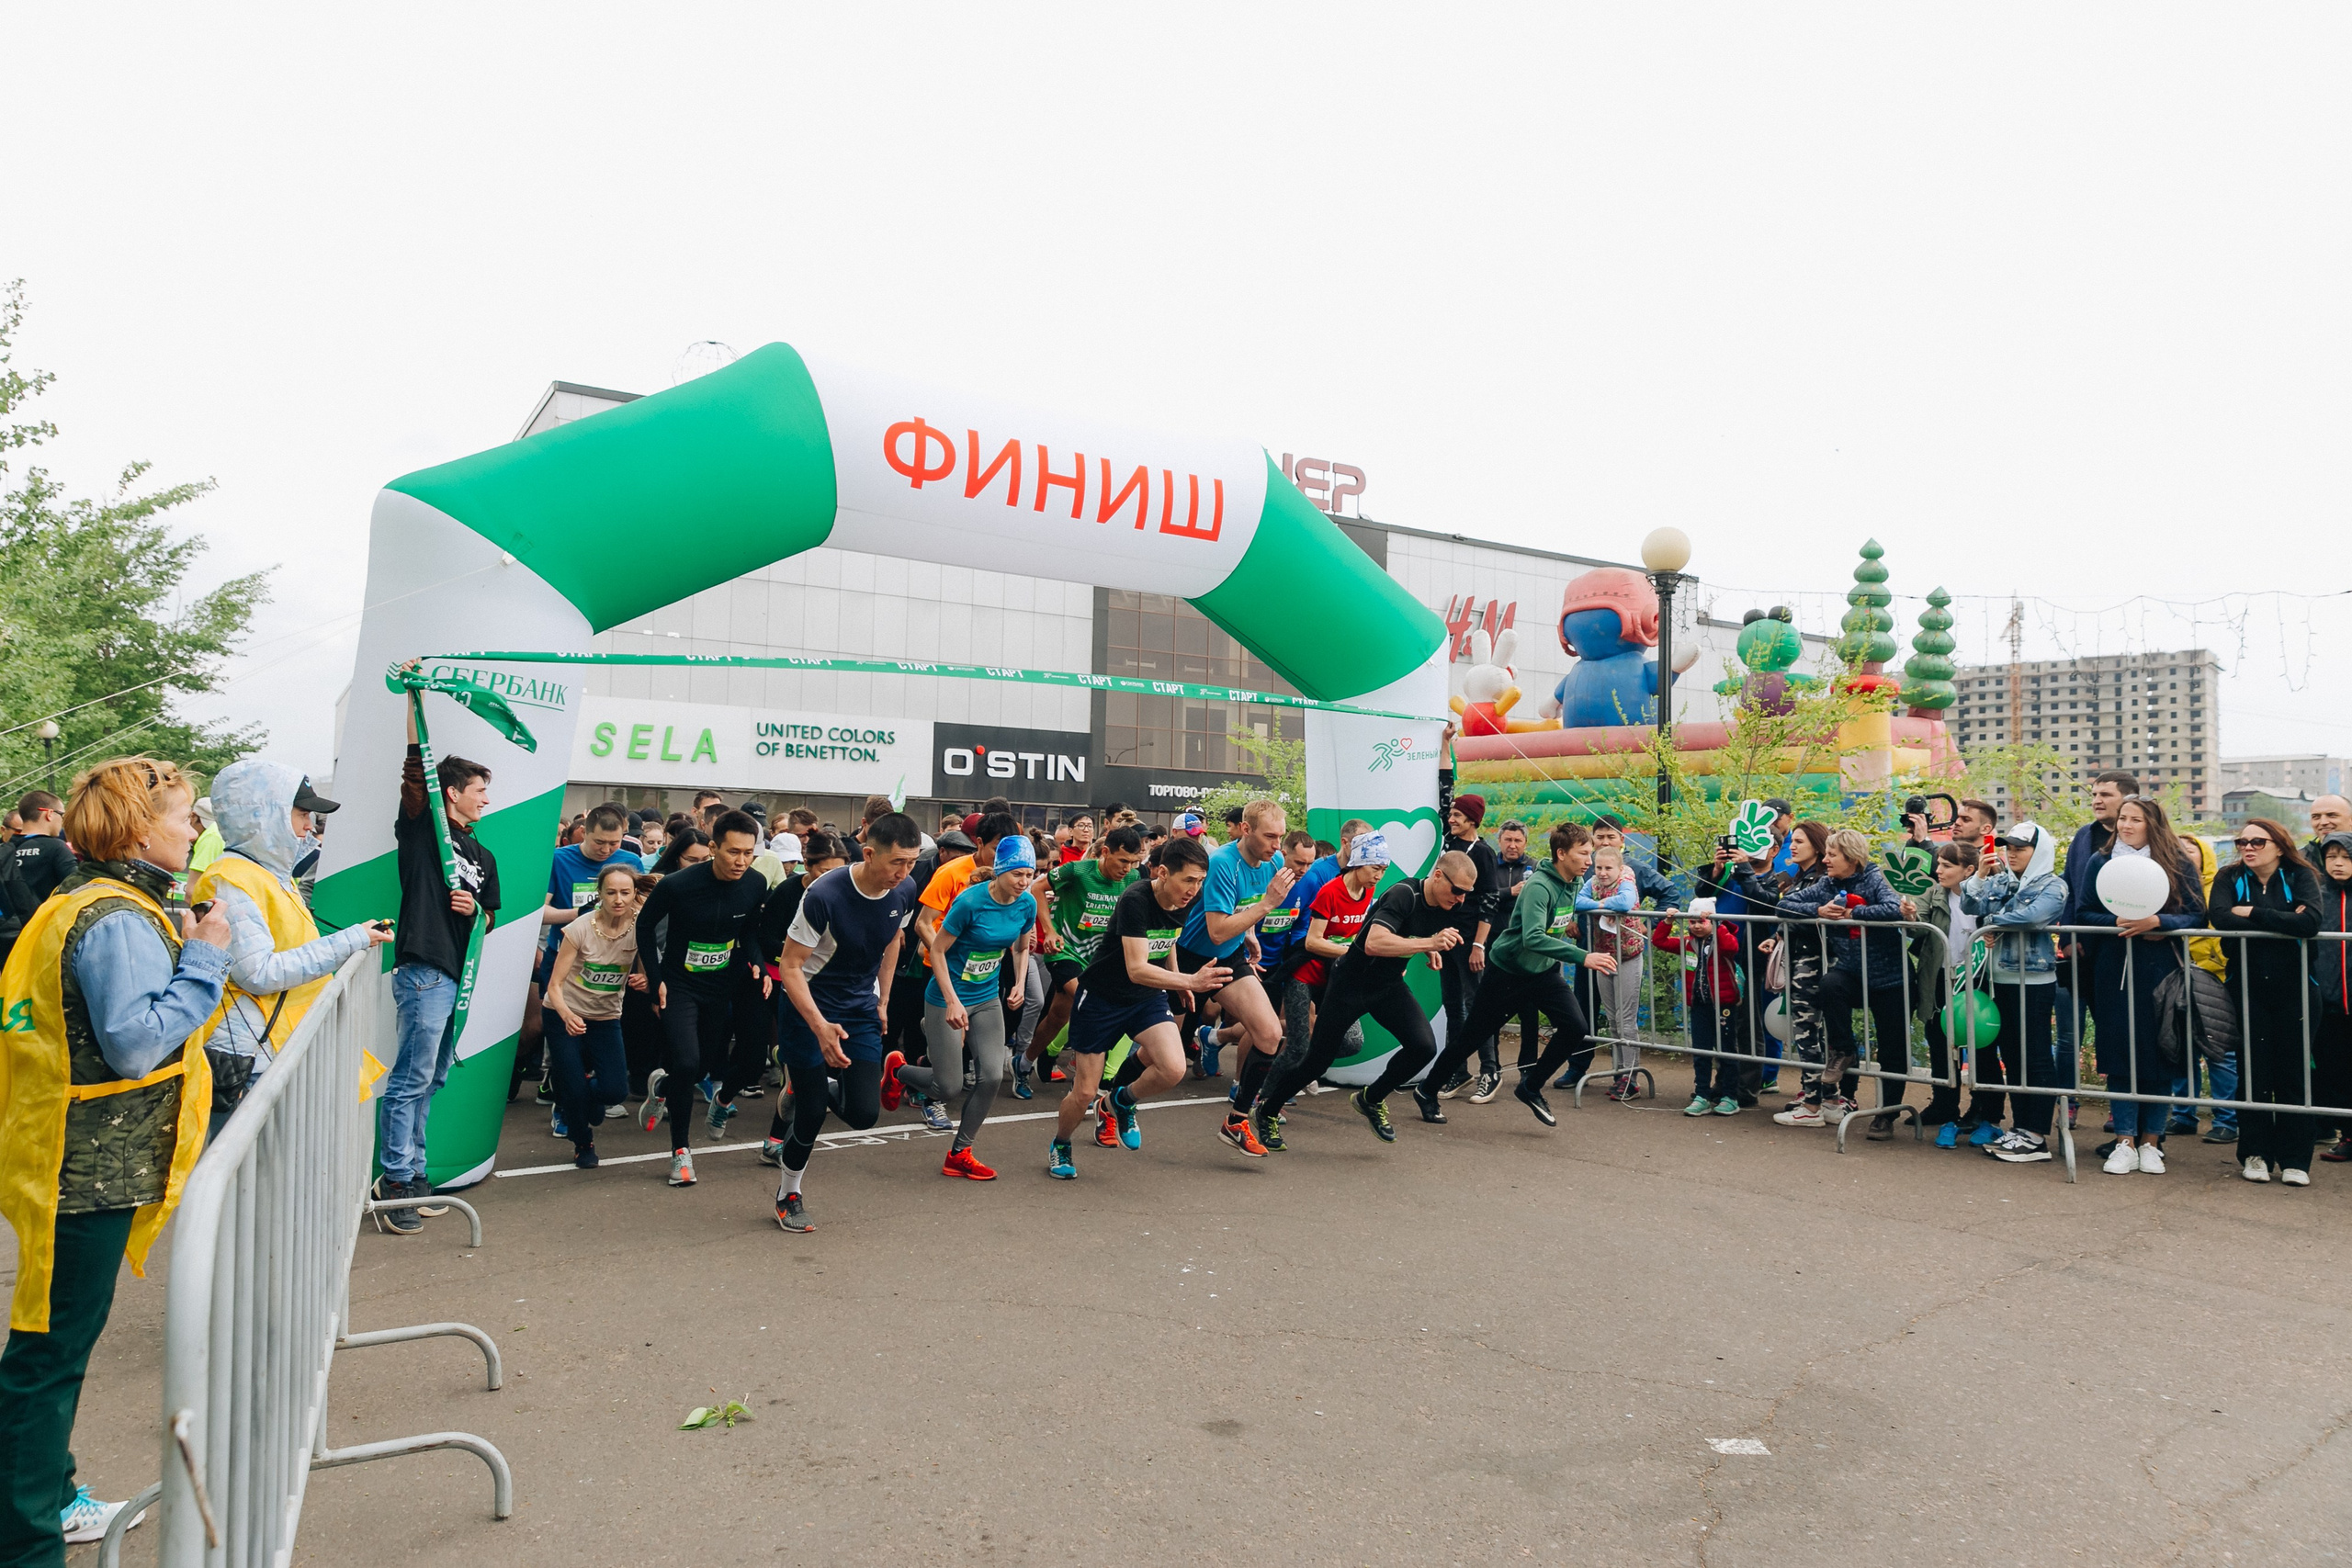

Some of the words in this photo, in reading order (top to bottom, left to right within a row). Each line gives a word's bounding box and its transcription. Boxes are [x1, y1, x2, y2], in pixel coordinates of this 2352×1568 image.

[883, 416, 1224, 542] ФИНИШ
[897, 661, 938, 672] СТАРТ
[985, 667, 1023, 678] СТАРТ
[1077, 673, 1113, 687] СТАРТ
[1152, 682, 1184, 695] СТАРТ
[1228, 689, 1258, 702] СТАРТ
[757, 722, 822, 742] UNITED
[828, 726, 896, 746] COLORS
[590, 722, 718, 763] SELA
[756, 741, 781, 757] OF
[16, 848, 40, 857] STER
[593, 974, 623, 983] 0127
